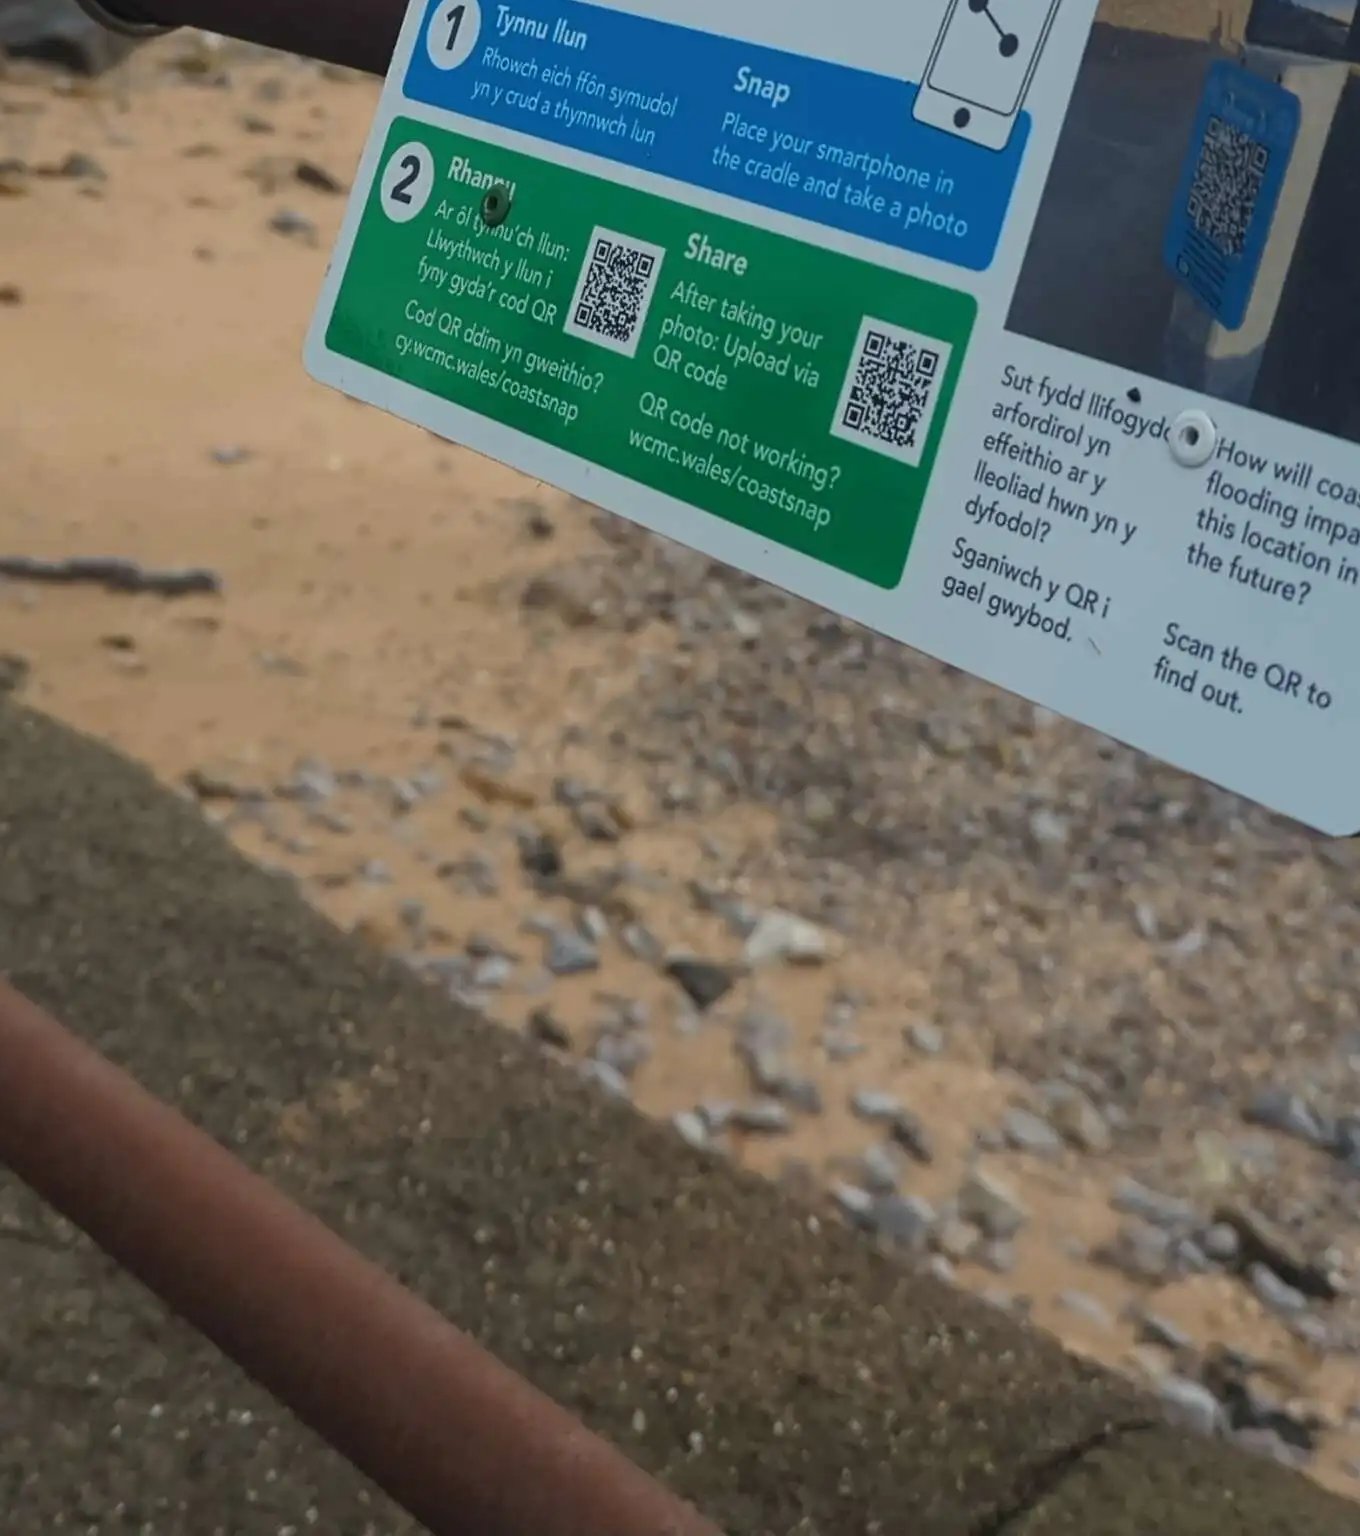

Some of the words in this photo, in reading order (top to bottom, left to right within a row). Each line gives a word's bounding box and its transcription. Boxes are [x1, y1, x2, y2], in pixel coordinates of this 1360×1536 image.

[446, 5, 465, 51] 1
[495, 4, 548, 40] Tynnu
[552, 18, 587, 51] llun
[470, 80, 491, 100] yn
[491, 87, 504, 106] y
[505, 88, 540, 112] crud
[540, 99, 550, 115] a
[554, 98, 627, 138] thynnwch
[630, 120, 656, 146] lun
[482, 46, 538, 79] Rhowch
[541, 64, 571, 89] eich
[575, 70, 606, 98] ffôn
[609, 85, 678, 119] symudol
[733, 65, 791, 108] Snap
[390, 155, 421, 205] 2
[721, 112, 768, 143] Place
[768, 130, 814, 156] your
[816, 142, 931, 189] smartphone
[934, 169, 955, 195] in
[712, 145, 740, 170] the
[744, 157, 800, 188] cradle
[803, 175, 841, 199] and
[843, 182, 885, 214] take
[888, 200, 900, 218] a
[904, 201, 969, 237] photo
[426, 227, 500, 271] Llwythwch
[500, 261, 514, 280] y
[515, 258, 543, 287] llun
[545, 270, 554, 289] i
[434, 199, 454, 220] Ar
[456, 205, 472, 227] ôl
[537, 230, 571, 262] llun:
[683, 232, 748, 276] Share
[417, 255, 448, 289] fyny
[448, 272, 496, 302] gyda'r
[499, 291, 530, 316] cod
[531, 298, 557, 325] QR
[670, 280, 717, 313] After
[720, 298, 776, 340] taking
[776, 322, 823, 350] your
[405, 299, 437, 327] Cod
[438, 312, 462, 338] QR
[463, 322, 501, 355] ddim
[501, 342, 522, 364] yn
[524, 352, 605, 394] gweithio?
[653, 344, 682, 374] QR
[684, 362, 728, 391] code
[659, 314, 720, 351] photo:
[723, 333, 791, 378] Upload
[794, 362, 820, 388] via
[395, 333, 579, 427] cy.wcmc.wales/coastsnap
[1001, 364, 1034, 395] Sut
[1038, 376, 1085, 411] fydd
[639, 391, 668, 420] QR
[670, 409, 714, 439] code
[717, 428, 751, 455] not
[753, 441, 841, 491] working?
[991, 401, 1084, 446] arfordirol
[1084, 434, 1111, 457] yn
[629, 429, 831, 532] wcmc.wales/coastsnap
[984, 431, 1062, 476] effeithio
[1067, 465, 1089, 485] ar
[1090, 474, 1107, 496] y
[1215, 437, 1269, 475] How
[1273, 461, 1314, 489] will
[964, 494, 1052, 543] dyfodol?
[974, 459, 1045, 505] lleoliad
[1047, 487, 1089, 522] hwn
[1090, 511, 1119, 535] yn
[1120, 524, 1137, 545] y
[1206, 469, 1299, 529] flooding
[952, 537, 1043, 591] Sganiwch
[1044, 581, 1060, 603] y
[1065, 583, 1100, 615] QR
[1101, 596, 1112, 619] i
[1187, 542, 1223, 574] the
[1228, 554, 1312, 606] future?
[1196, 507, 1236, 540] this
[1240, 520, 1331, 576] location
[1337, 557, 1360, 585] in
[942, 575, 987, 605] gael
[986, 594, 1072, 642] gwybod.
[1153, 655, 1199, 693] find
[1201, 682, 1243, 714] out.
[1162, 622, 1215, 662] Scan
[1221, 646, 1258, 680] the
[1264, 663, 1303, 698] QR
[1306, 681, 1333, 710] to
